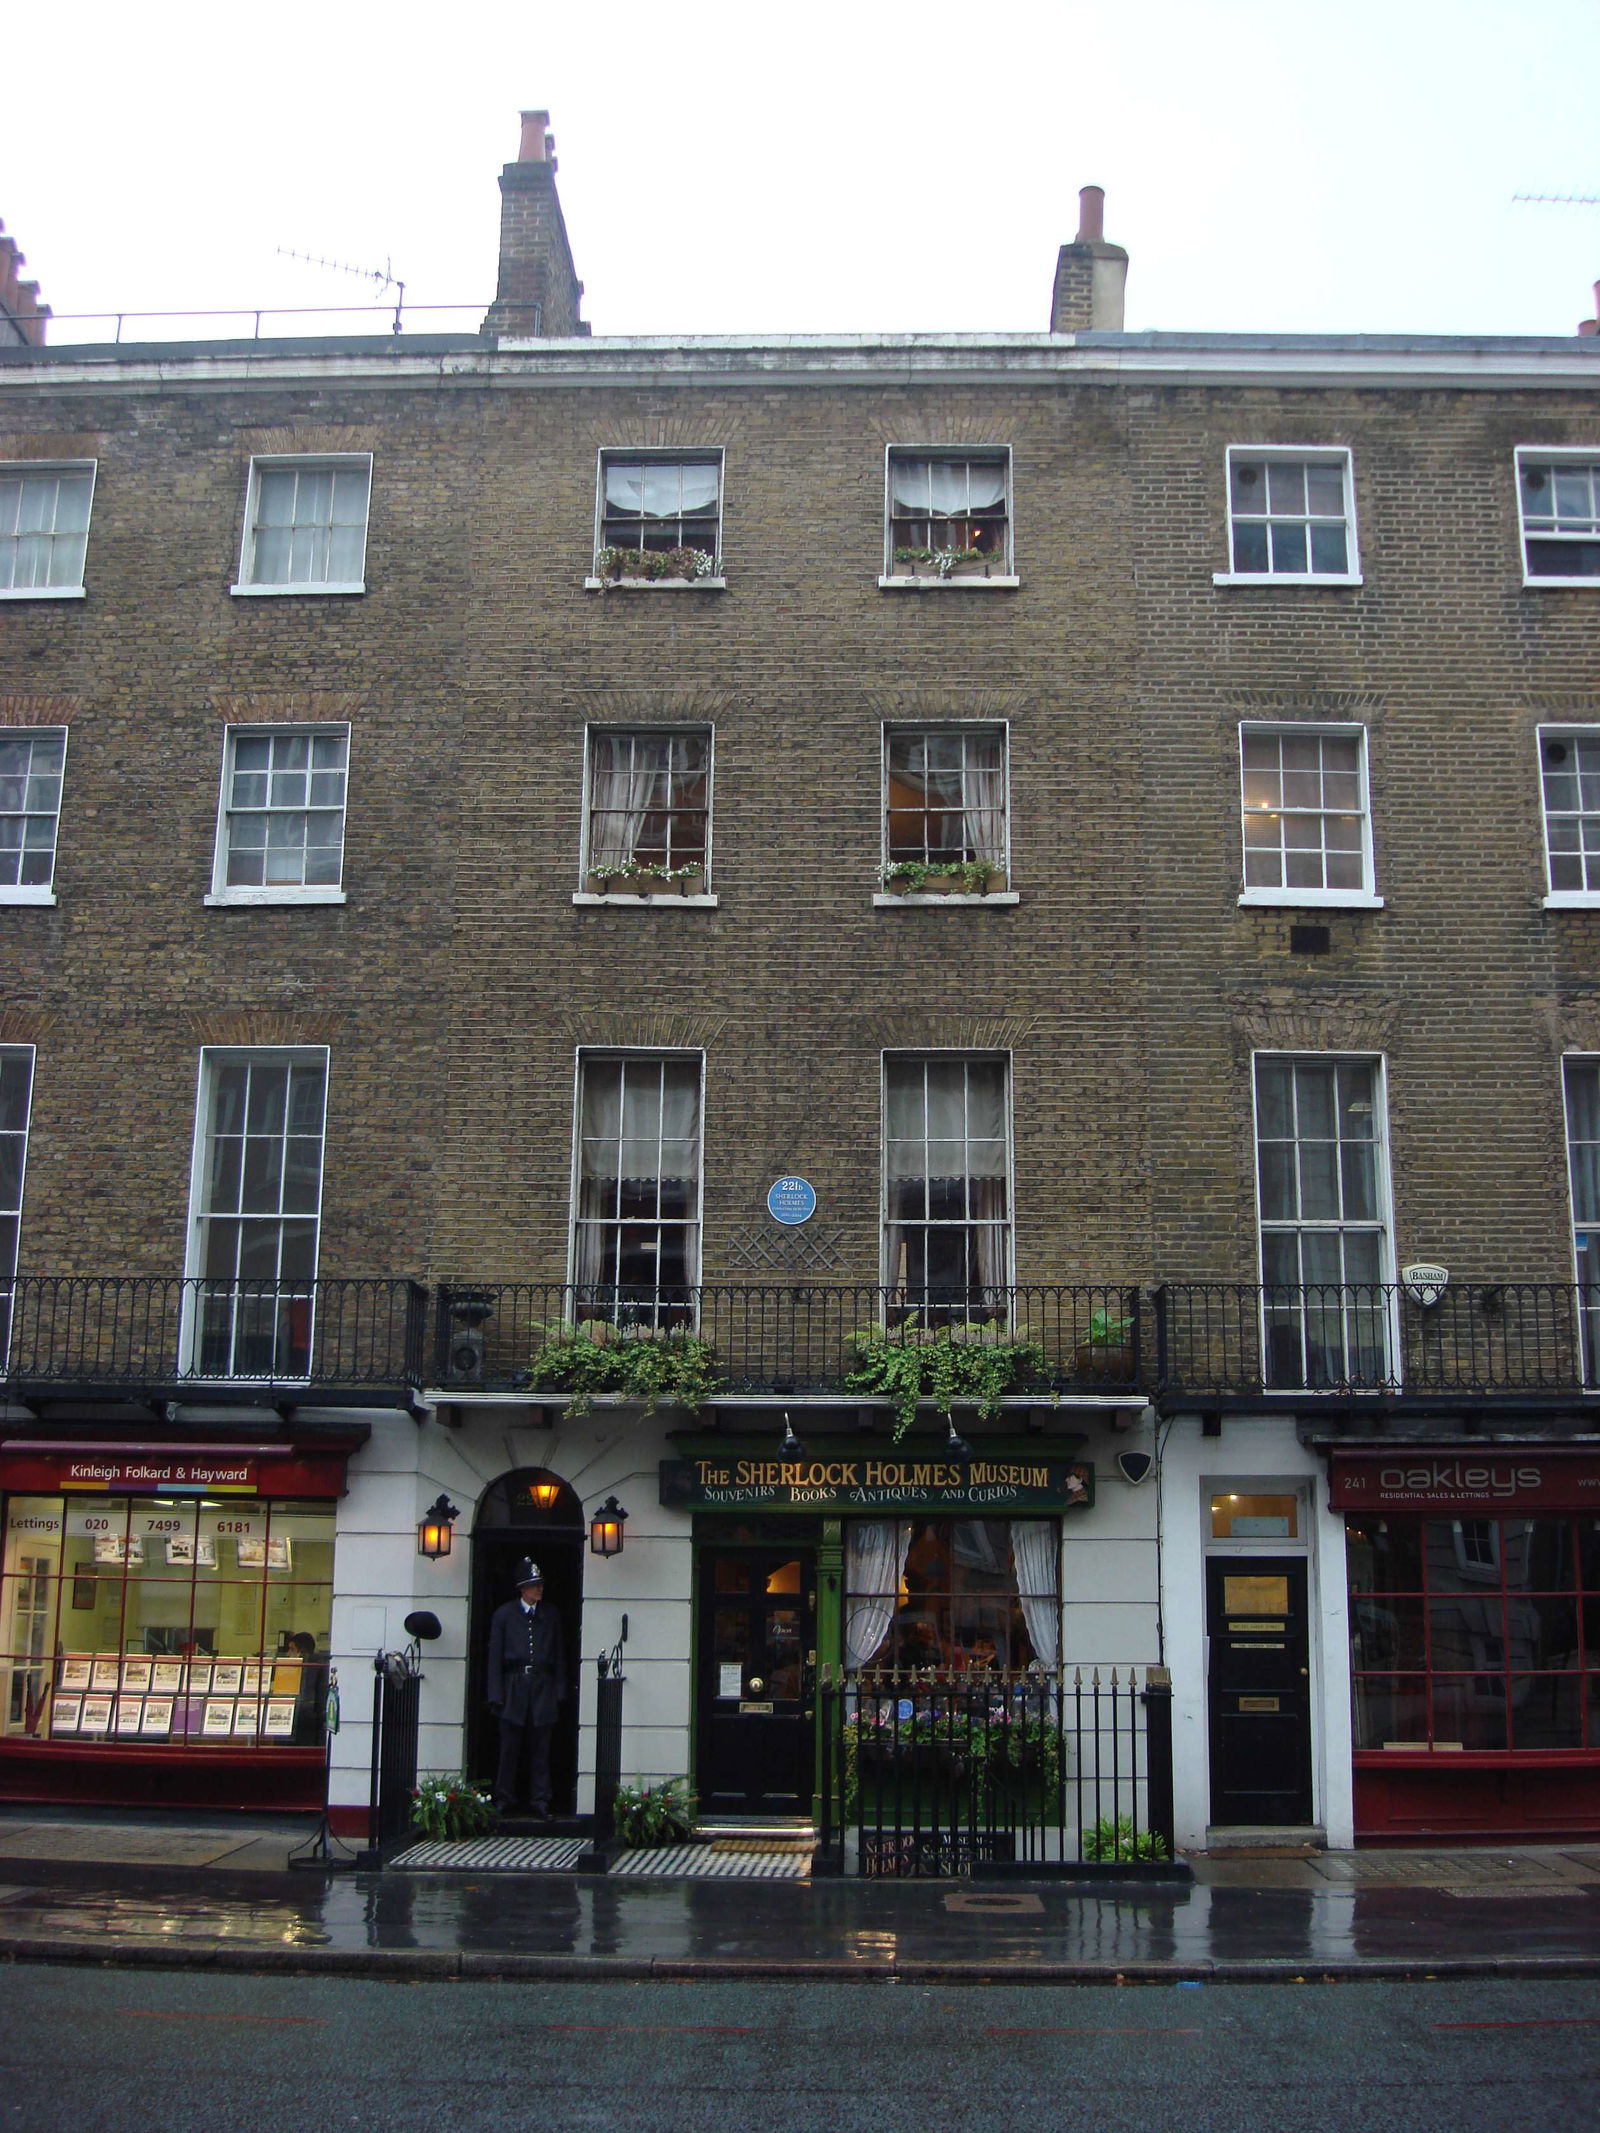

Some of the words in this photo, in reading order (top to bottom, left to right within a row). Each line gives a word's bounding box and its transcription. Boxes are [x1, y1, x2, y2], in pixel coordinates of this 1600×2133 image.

[1412, 1271, 1443, 1281] BANHAM
[71, 1465, 120, 1481] Kinleigh
[125, 1465, 171, 1479] Folkard
[176, 1467, 186, 1479] &
[191, 1467, 248, 1483] Hayward
[695, 1461, 730, 1485] THE
[735, 1460, 859, 1486] SHERLOCK
[865, 1460, 961, 1486] HOLMES
[969, 1462, 1048, 1488] MUSEUM
[1379, 1461, 1542, 1497] oakleys
[1344, 1477, 1366, 1489] 241
[704, 1485, 776, 1502] SOUVENIRS
[790, 1486, 837, 1502] BOOKS
[849, 1486, 928, 1502] ANTIQUES
[940, 1488, 965, 1500] AND
[967, 1485, 1018, 1503] CURIOS
[10, 1517, 60, 1532] Lettings
[85, 1518, 109, 1530] 020
[147, 1519, 181, 1531] 7499
[217, 1521, 251, 1533] 6181
[943, 1834, 983, 1845] MSEM
